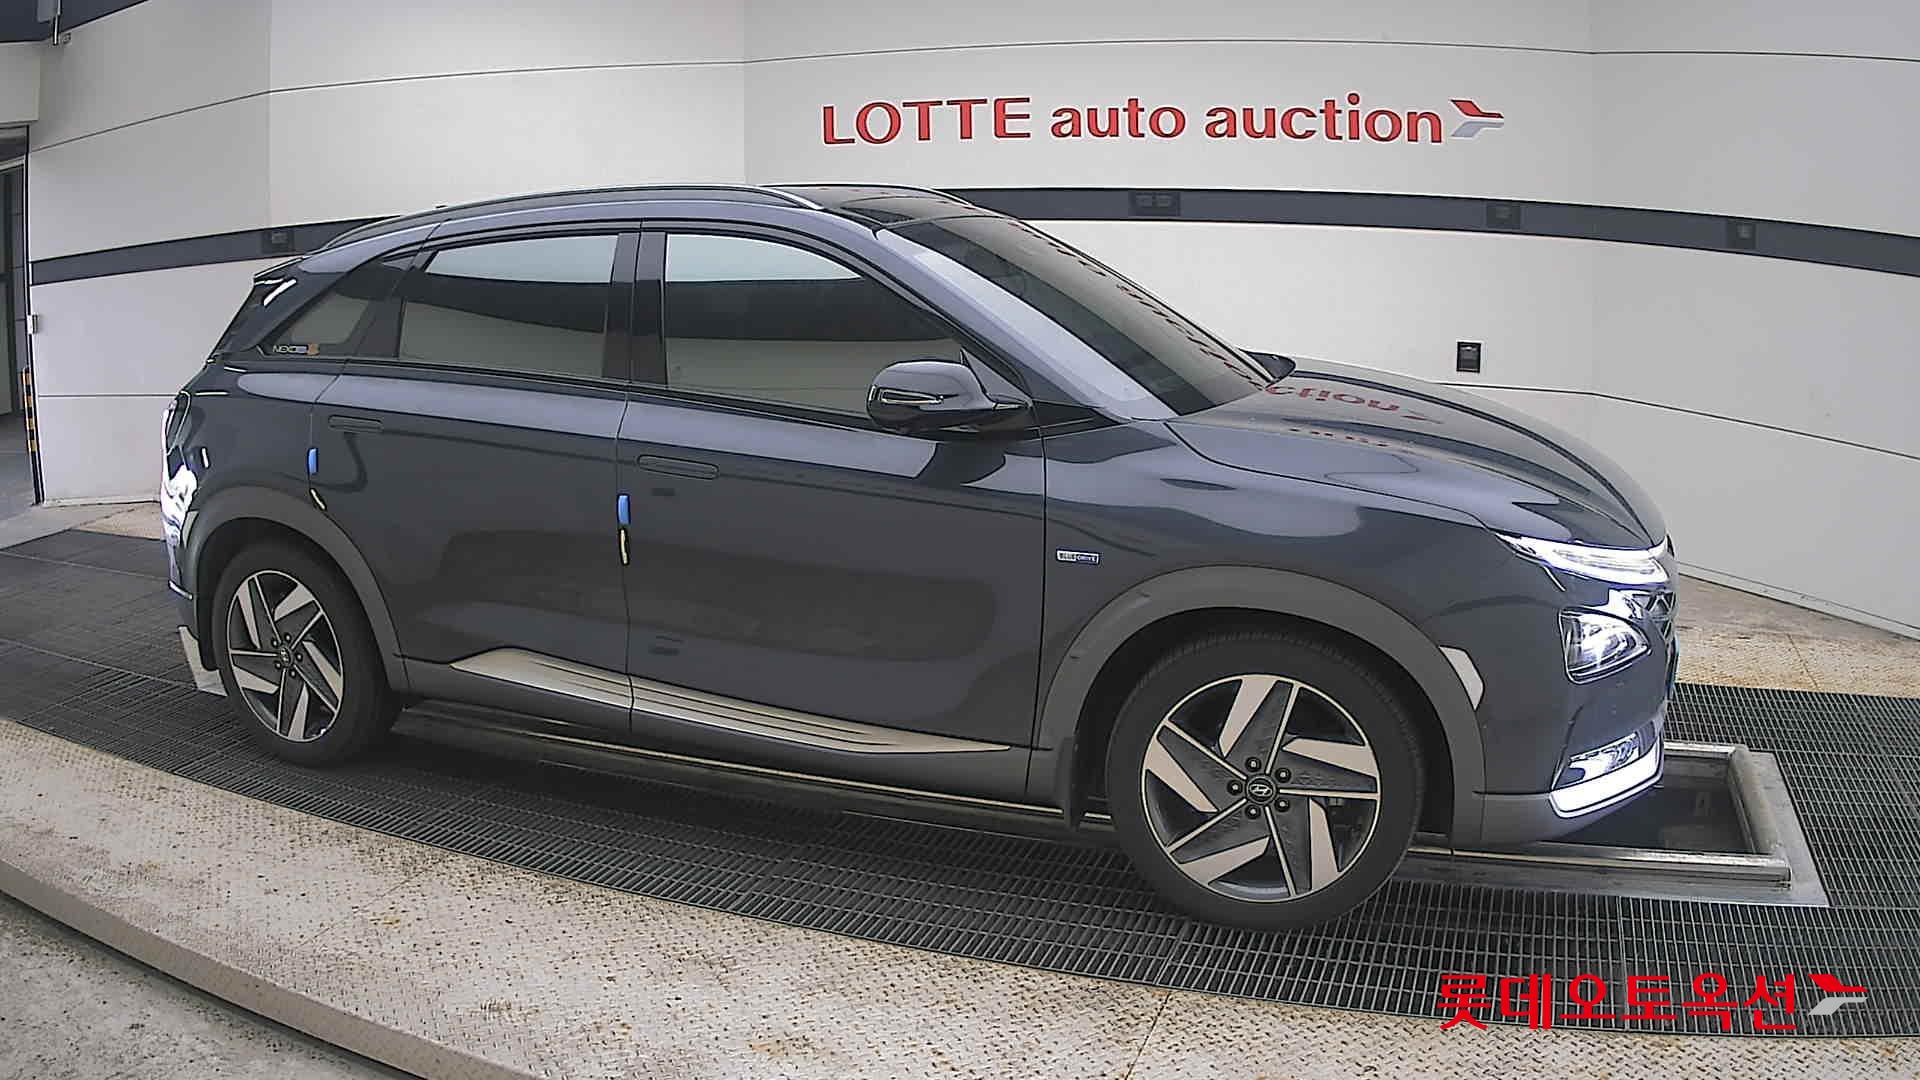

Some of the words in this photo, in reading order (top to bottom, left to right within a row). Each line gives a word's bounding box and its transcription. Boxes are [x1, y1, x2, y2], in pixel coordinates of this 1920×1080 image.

[822, 97, 1031, 145] LOTTE
[1050, 97, 1186, 139] auto
[1205, 94, 1443, 143] auction
